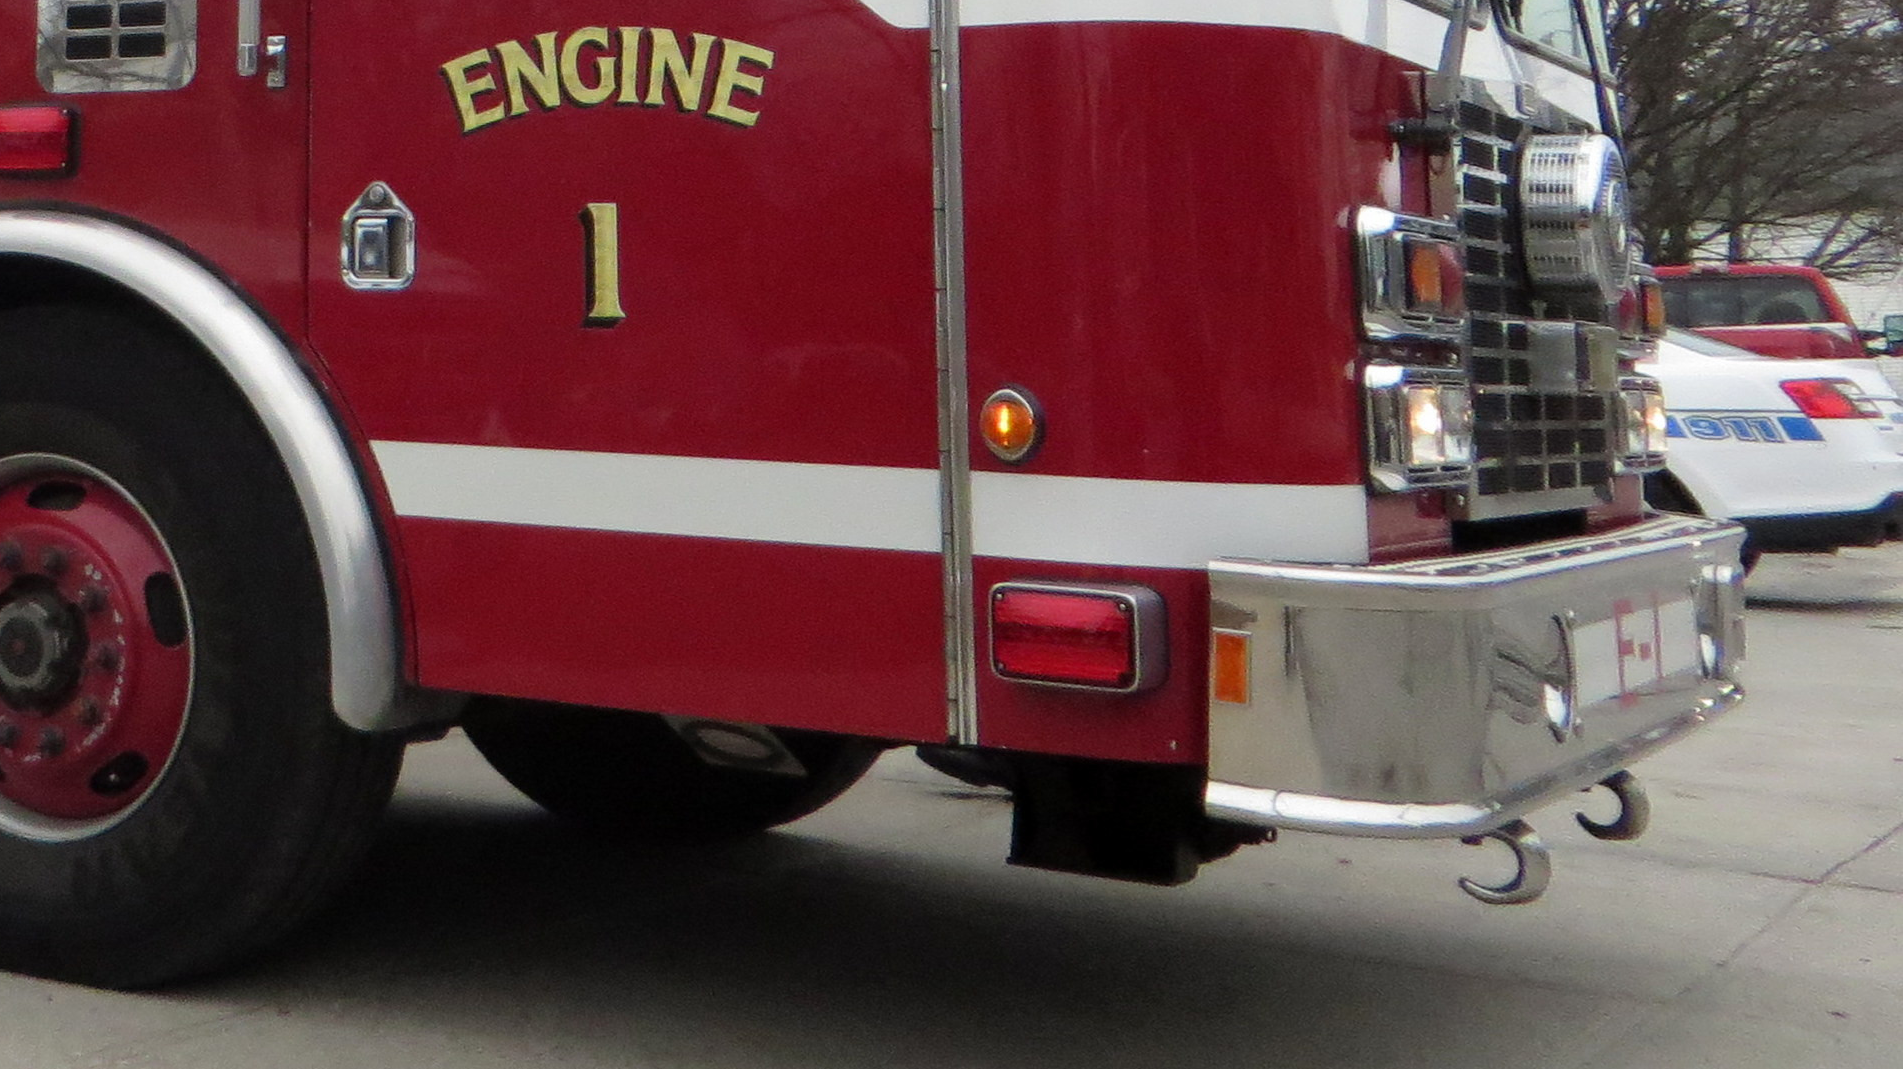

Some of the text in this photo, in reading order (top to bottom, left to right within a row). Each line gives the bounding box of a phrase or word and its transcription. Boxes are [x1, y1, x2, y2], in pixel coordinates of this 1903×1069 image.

[441, 26, 776, 133] ENGINE
[581, 202, 626, 328] 1
[1683, 415, 1785, 443] 911
